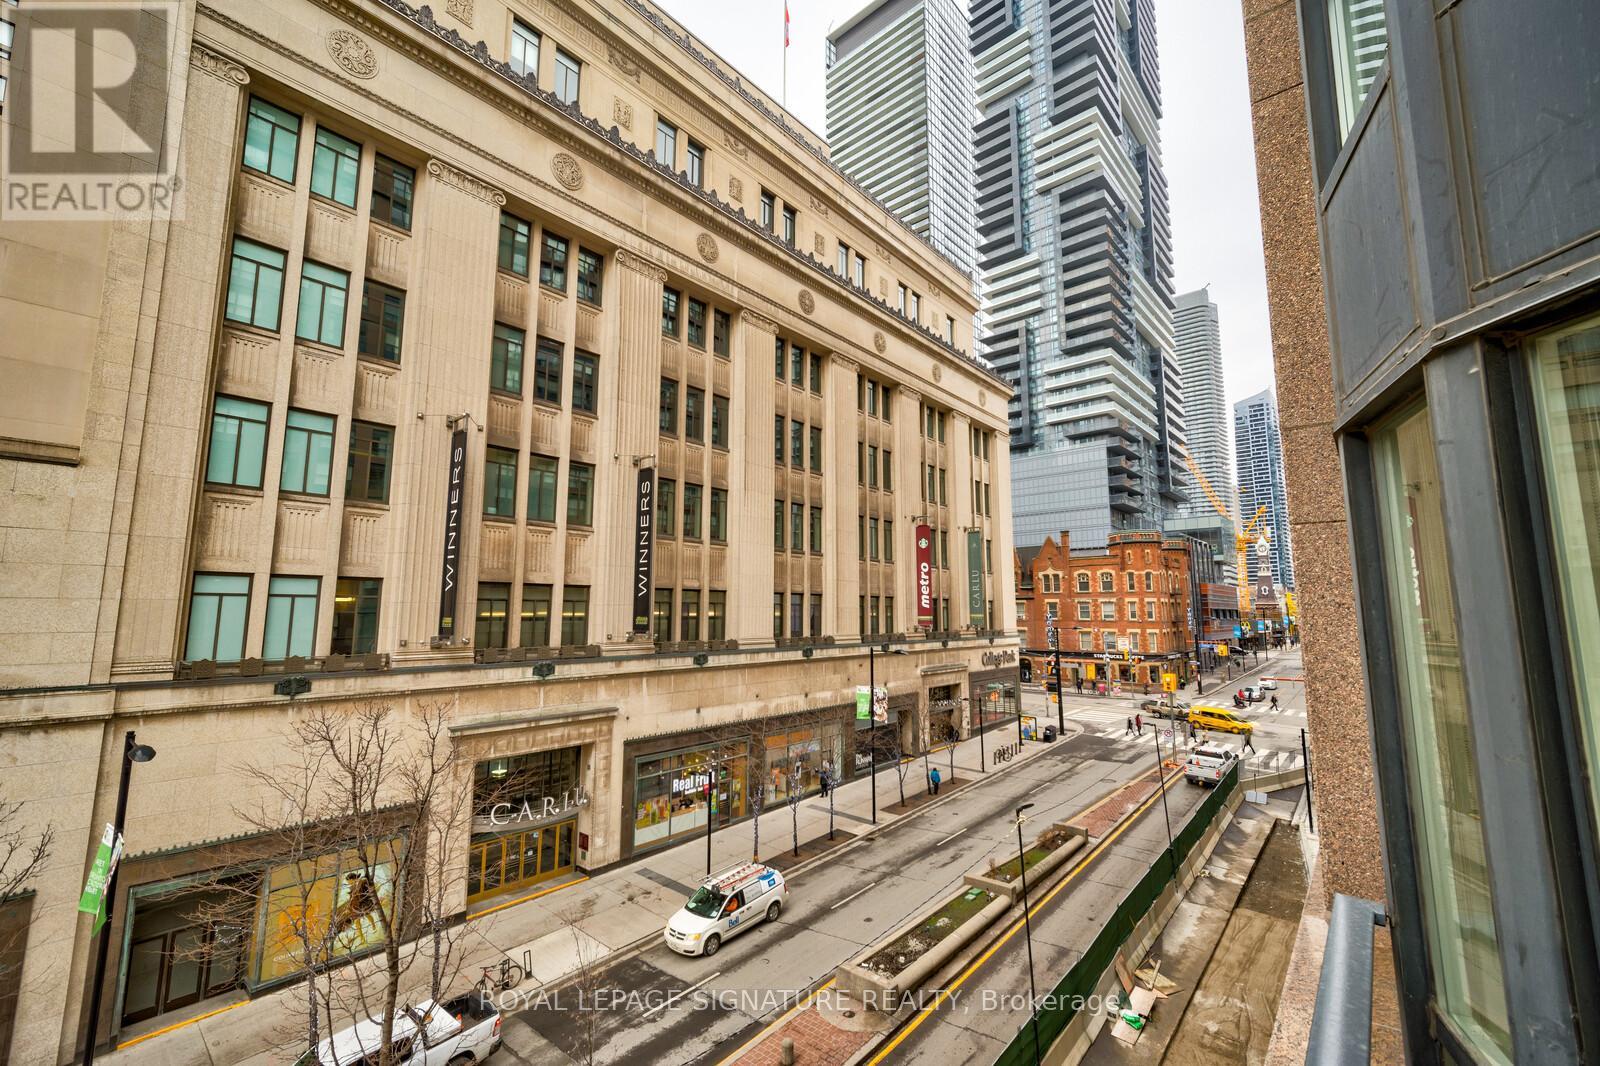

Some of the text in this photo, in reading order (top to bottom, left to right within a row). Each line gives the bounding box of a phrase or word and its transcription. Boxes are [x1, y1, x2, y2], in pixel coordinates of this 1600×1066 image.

[445, 446, 463, 592] WINNERS
[638, 480, 650, 597] WINNERS
[920, 562, 930, 609] metro
[972, 570, 980, 608] CARLU
[673, 774, 694, 793] Real
[695, 771, 716, 787] Frut
[728, 915, 740, 928] Bell
